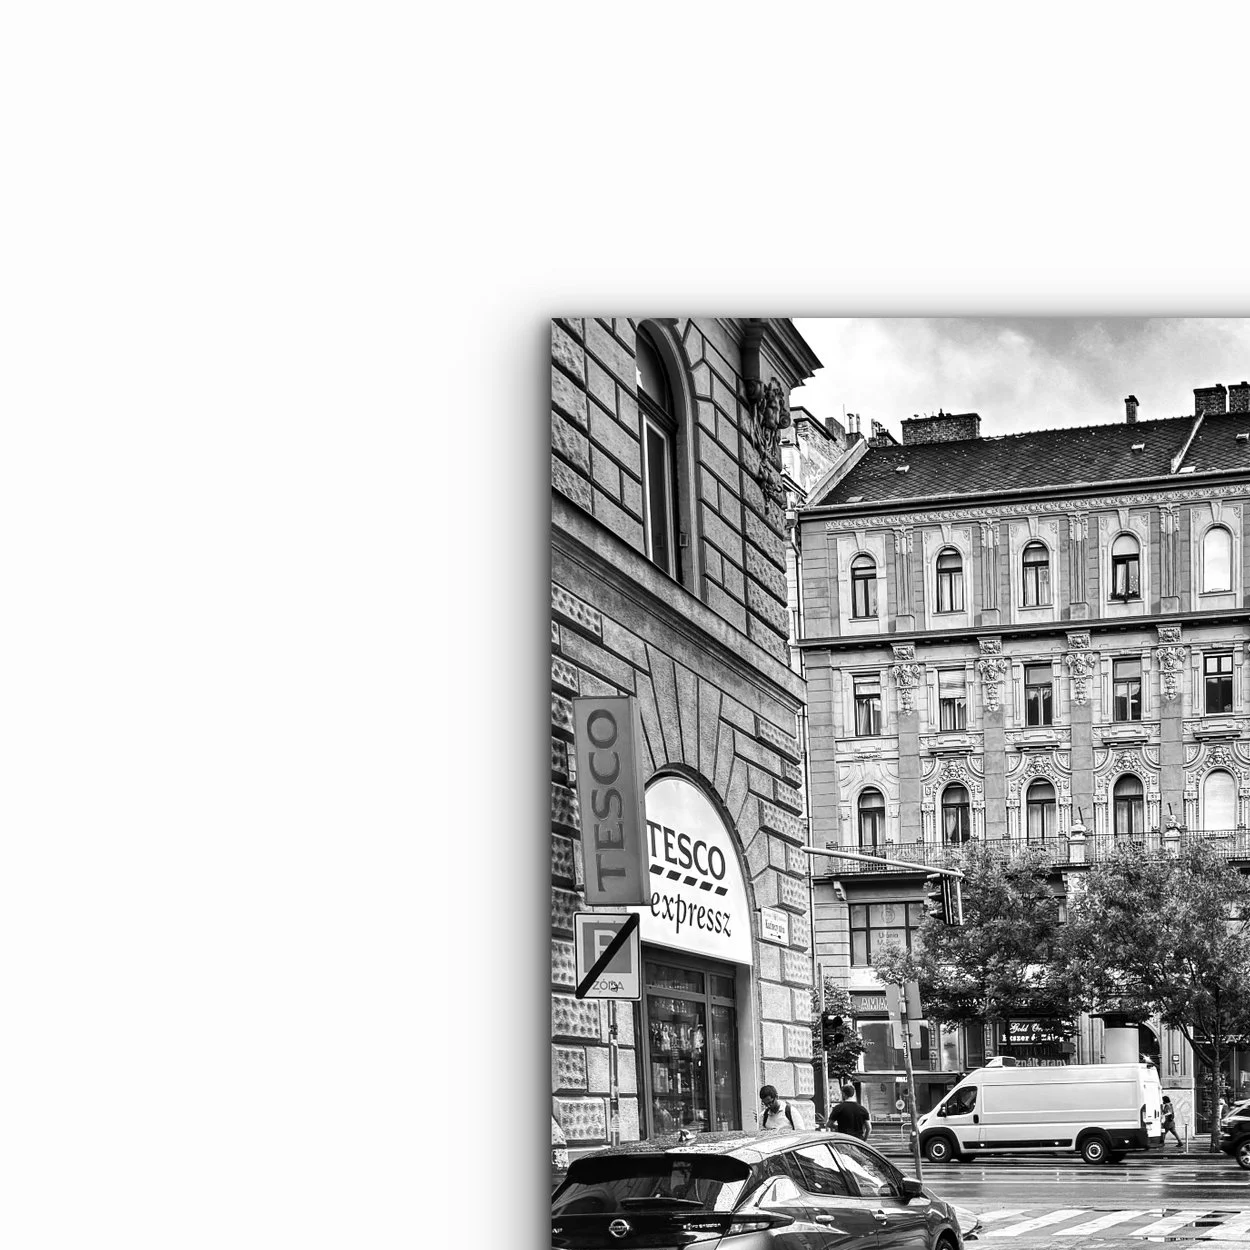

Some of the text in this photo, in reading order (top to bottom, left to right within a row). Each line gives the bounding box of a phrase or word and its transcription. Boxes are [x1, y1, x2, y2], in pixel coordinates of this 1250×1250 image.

[586, 708, 627, 893] TESCO
[647, 819, 726, 881] TESCO
[650, 891, 732, 938] expressz
